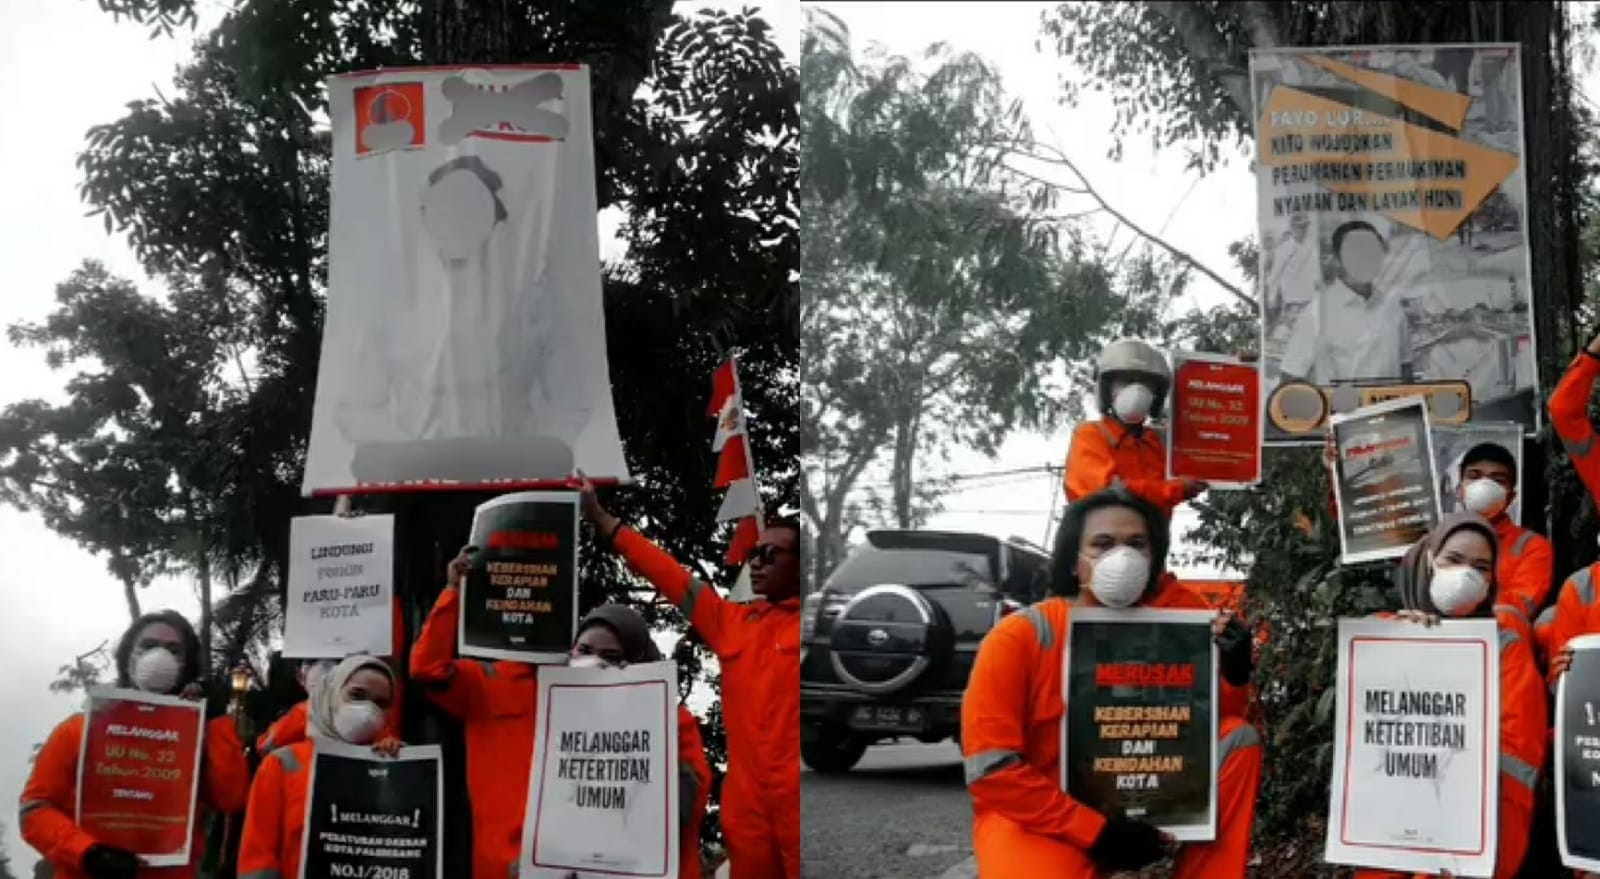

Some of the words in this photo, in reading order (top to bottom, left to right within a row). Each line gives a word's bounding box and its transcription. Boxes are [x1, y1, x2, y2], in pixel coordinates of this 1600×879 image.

[1272, 161, 1362, 185] PERUMAHAN
[1367, 159, 1466, 181] PERMUKIMAN
[1274, 192, 1332, 216] NYAMAN
[1338, 192, 1368, 211] DAN
[1374, 189, 1421, 211] LAYAK
[1424, 189, 1462, 209] HUNI
[311, 543, 374, 559] LINDUNGI
[506, 588, 532, 599] DAN
[320, 604, 359, 618] KOTA
[501, 612, 534, 624] KOTA
[1095, 663, 1195, 686] MERUSAK
[1365, 689, 1466, 716] MELANGGAR
[1094, 706, 1191, 722] KEBERSIHAN
[105, 724, 180, 742] MELANGGAR
[1100, 723, 1178, 739] KERAPIAN
[1364, 720, 1466, 748] KETERTIBAN
[560, 730, 651, 753] MELANGGAR
[1121, 740, 1156, 755] DAN
[558, 757, 650, 782] KETERTIBAN
[1094, 756, 1184, 772] KEINDAHAN
[1385, 752, 1437, 778] UMUM
[142, 767, 182, 780] 2009
[1116, 774, 1160, 789] KOTA
[576, 784, 626, 809] UMUM
[340, 812, 411, 825] MELANGGAR
